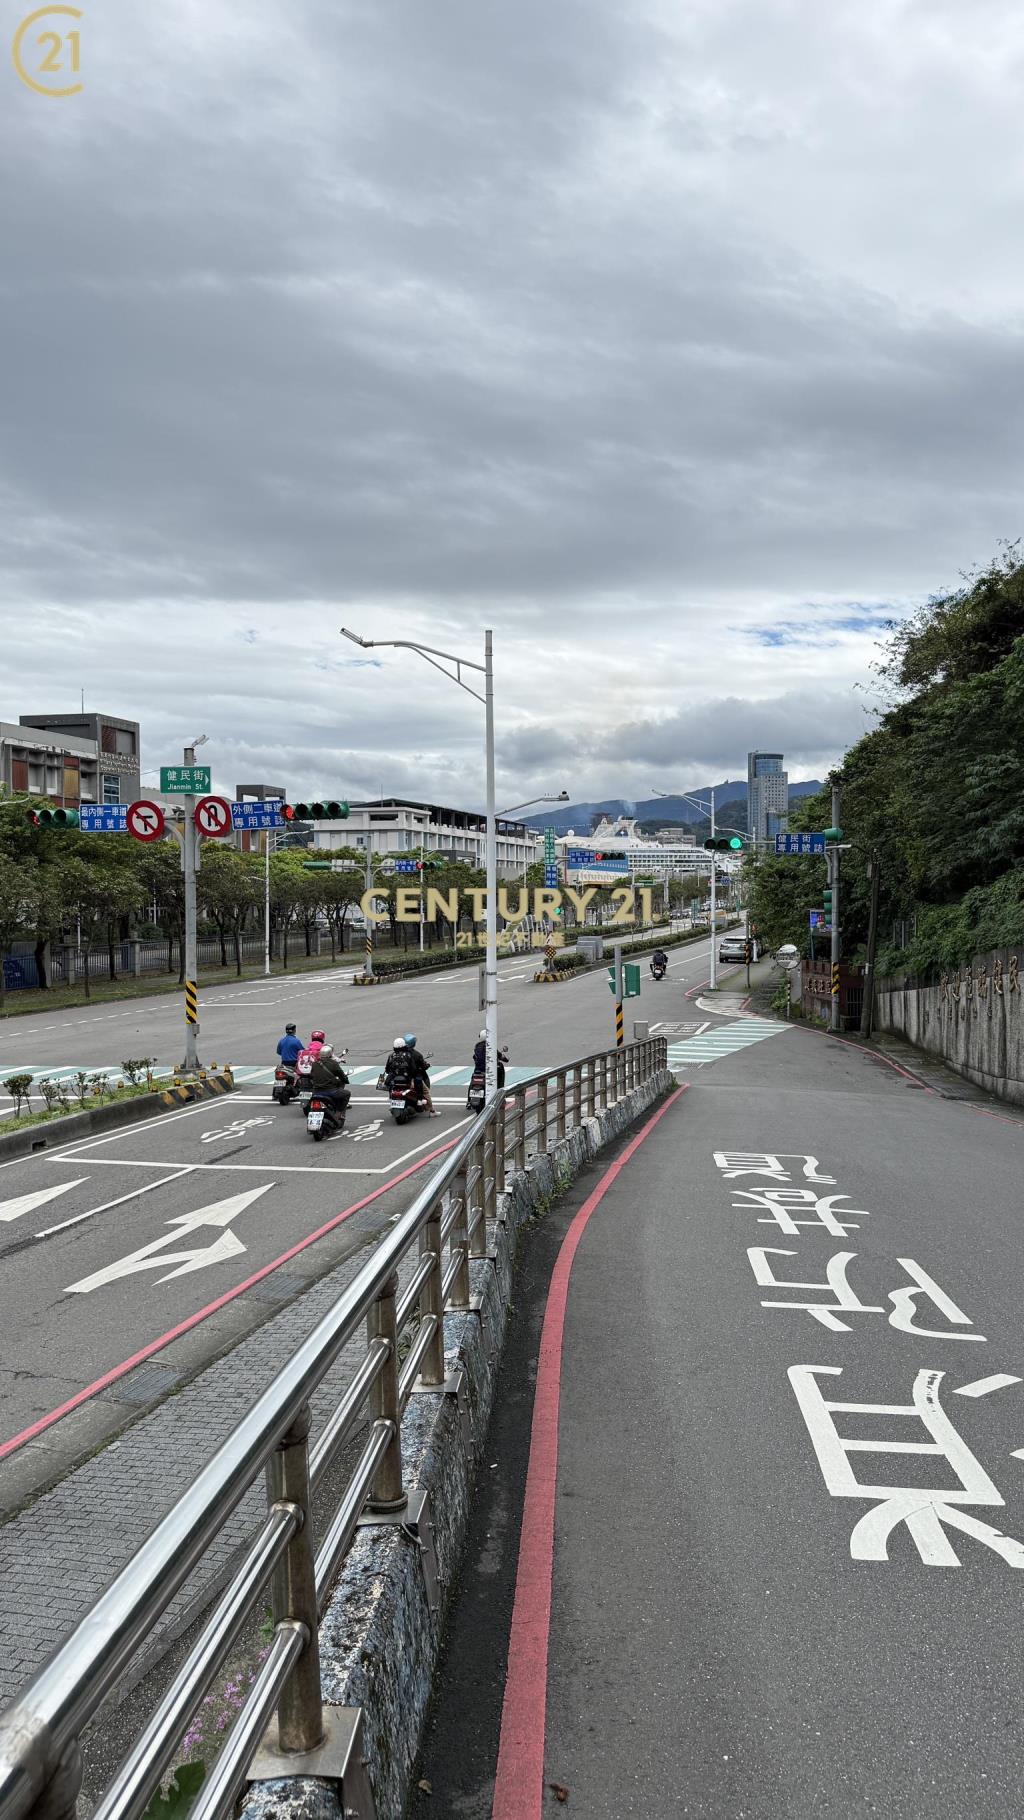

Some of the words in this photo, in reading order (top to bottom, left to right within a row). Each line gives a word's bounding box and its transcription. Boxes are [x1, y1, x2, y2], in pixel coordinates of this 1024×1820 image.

[167, 770, 204, 781] 健民街
[167, 783, 192, 791] Jianmin
[195, 783, 203, 791] St.
[81, 806, 127, 817] 最內側一車道
[232, 802, 282, 816] 外側二車道
[81, 819, 127, 830] 專用號誌
[234, 815, 285, 828] 專用號誌
[777, 834, 812, 843] 健民街
[777, 843, 823, 853] 專用號誌
